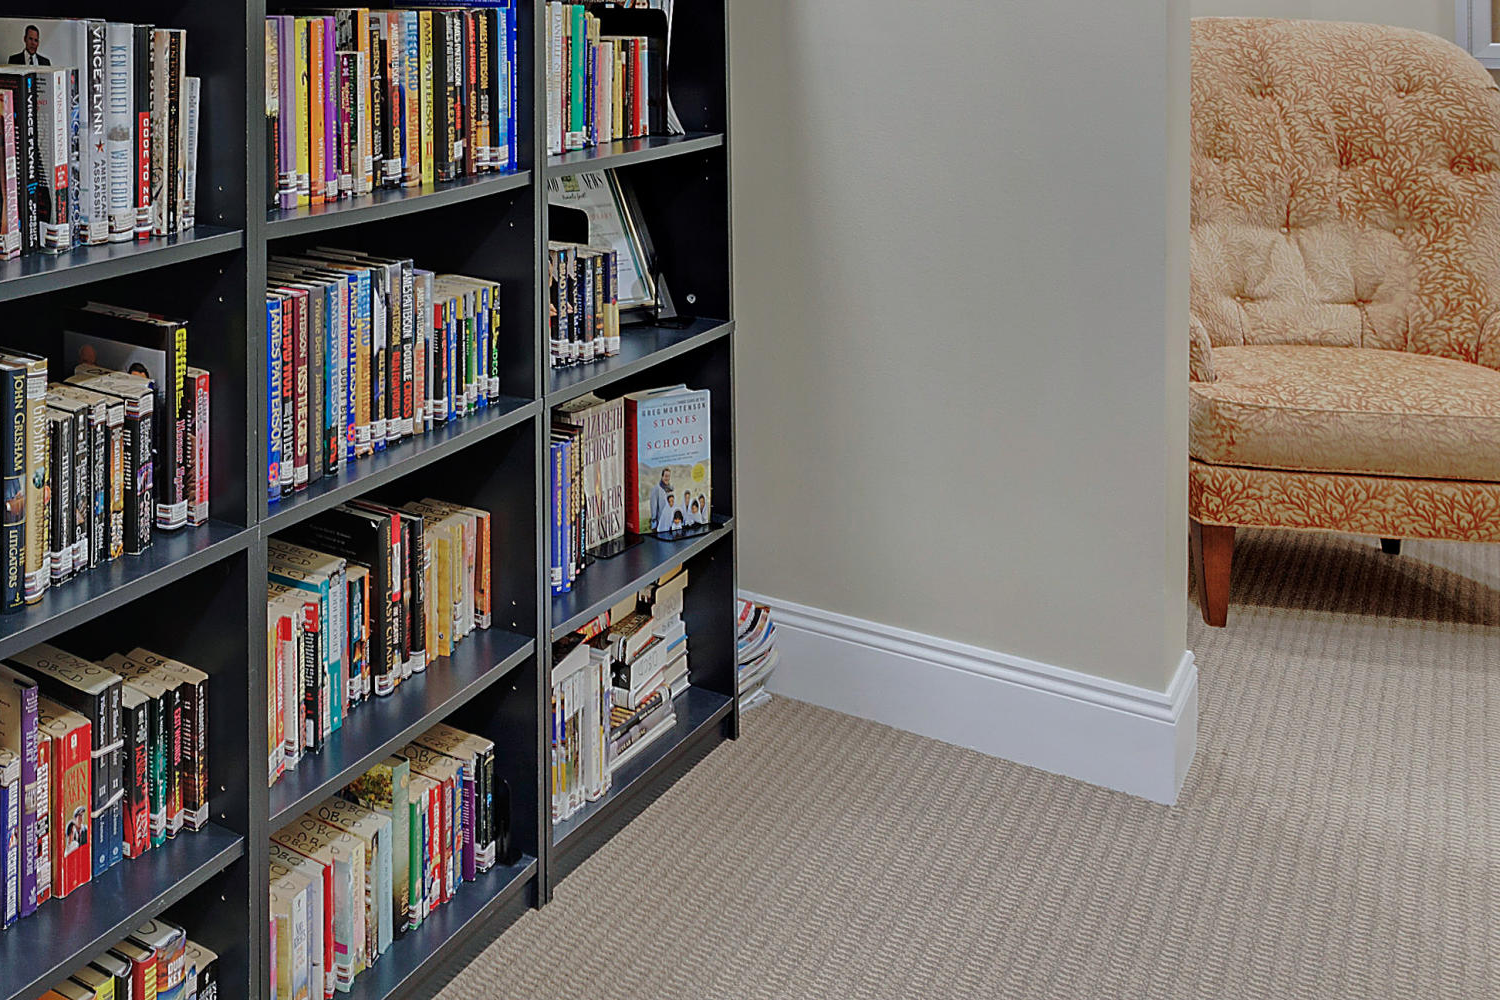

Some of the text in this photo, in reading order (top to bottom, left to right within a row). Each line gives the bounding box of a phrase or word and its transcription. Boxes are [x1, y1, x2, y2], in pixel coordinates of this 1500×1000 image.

[110, 45, 128, 210] KEN WHITEOUT
[13, 374, 25, 472] JOHN GRISHAM
[647, 433, 704, 450] SCHOOLS
[653, 414, 697, 428] STONES
